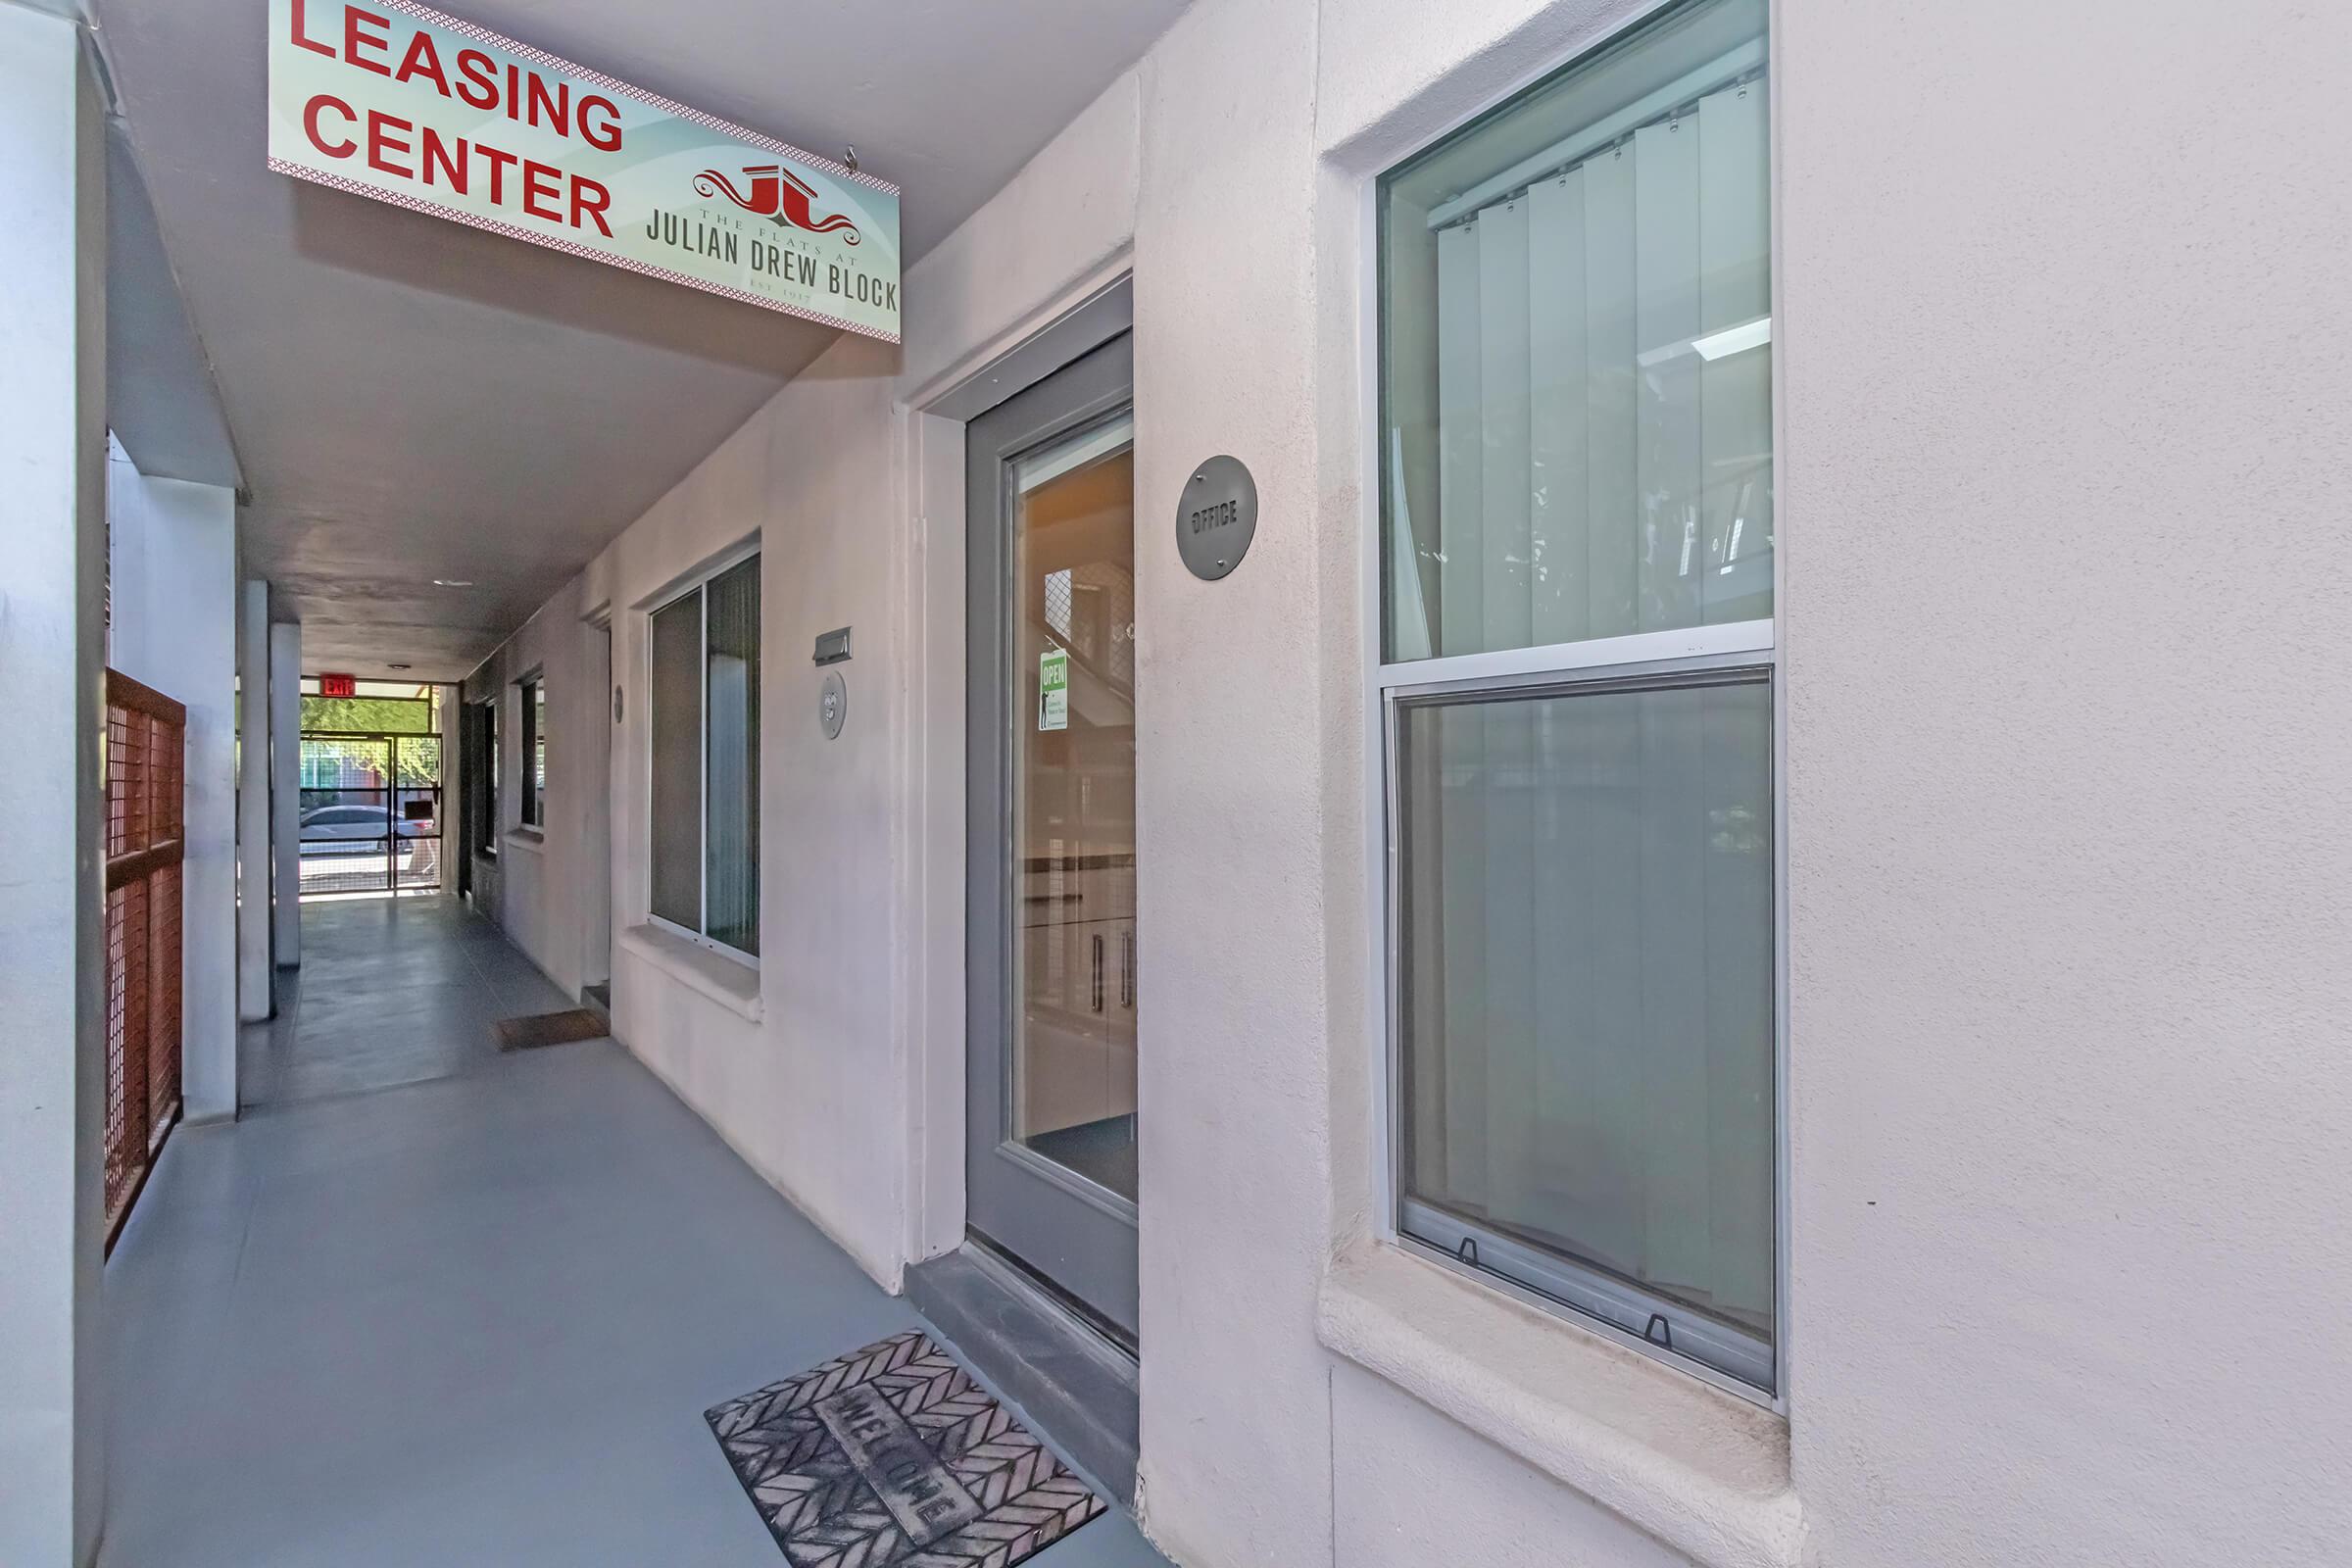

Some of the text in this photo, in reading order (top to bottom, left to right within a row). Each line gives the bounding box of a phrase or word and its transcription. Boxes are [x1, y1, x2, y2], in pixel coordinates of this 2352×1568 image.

[291, 0, 622, 152] LEASING
[303, 94, 613, 238] CENTER
[646, 209, 897, 312] JULIAN DREW BLOCK
[700, 209, 858, 266] THE FLATS AT
[1192, 500, 1237, 534] OFFICE
[324, 678, 352, 695] EXIT
[1043, 662, 1064, 686] OPEN
[834, 1396, 956, 1523] WELCOME
